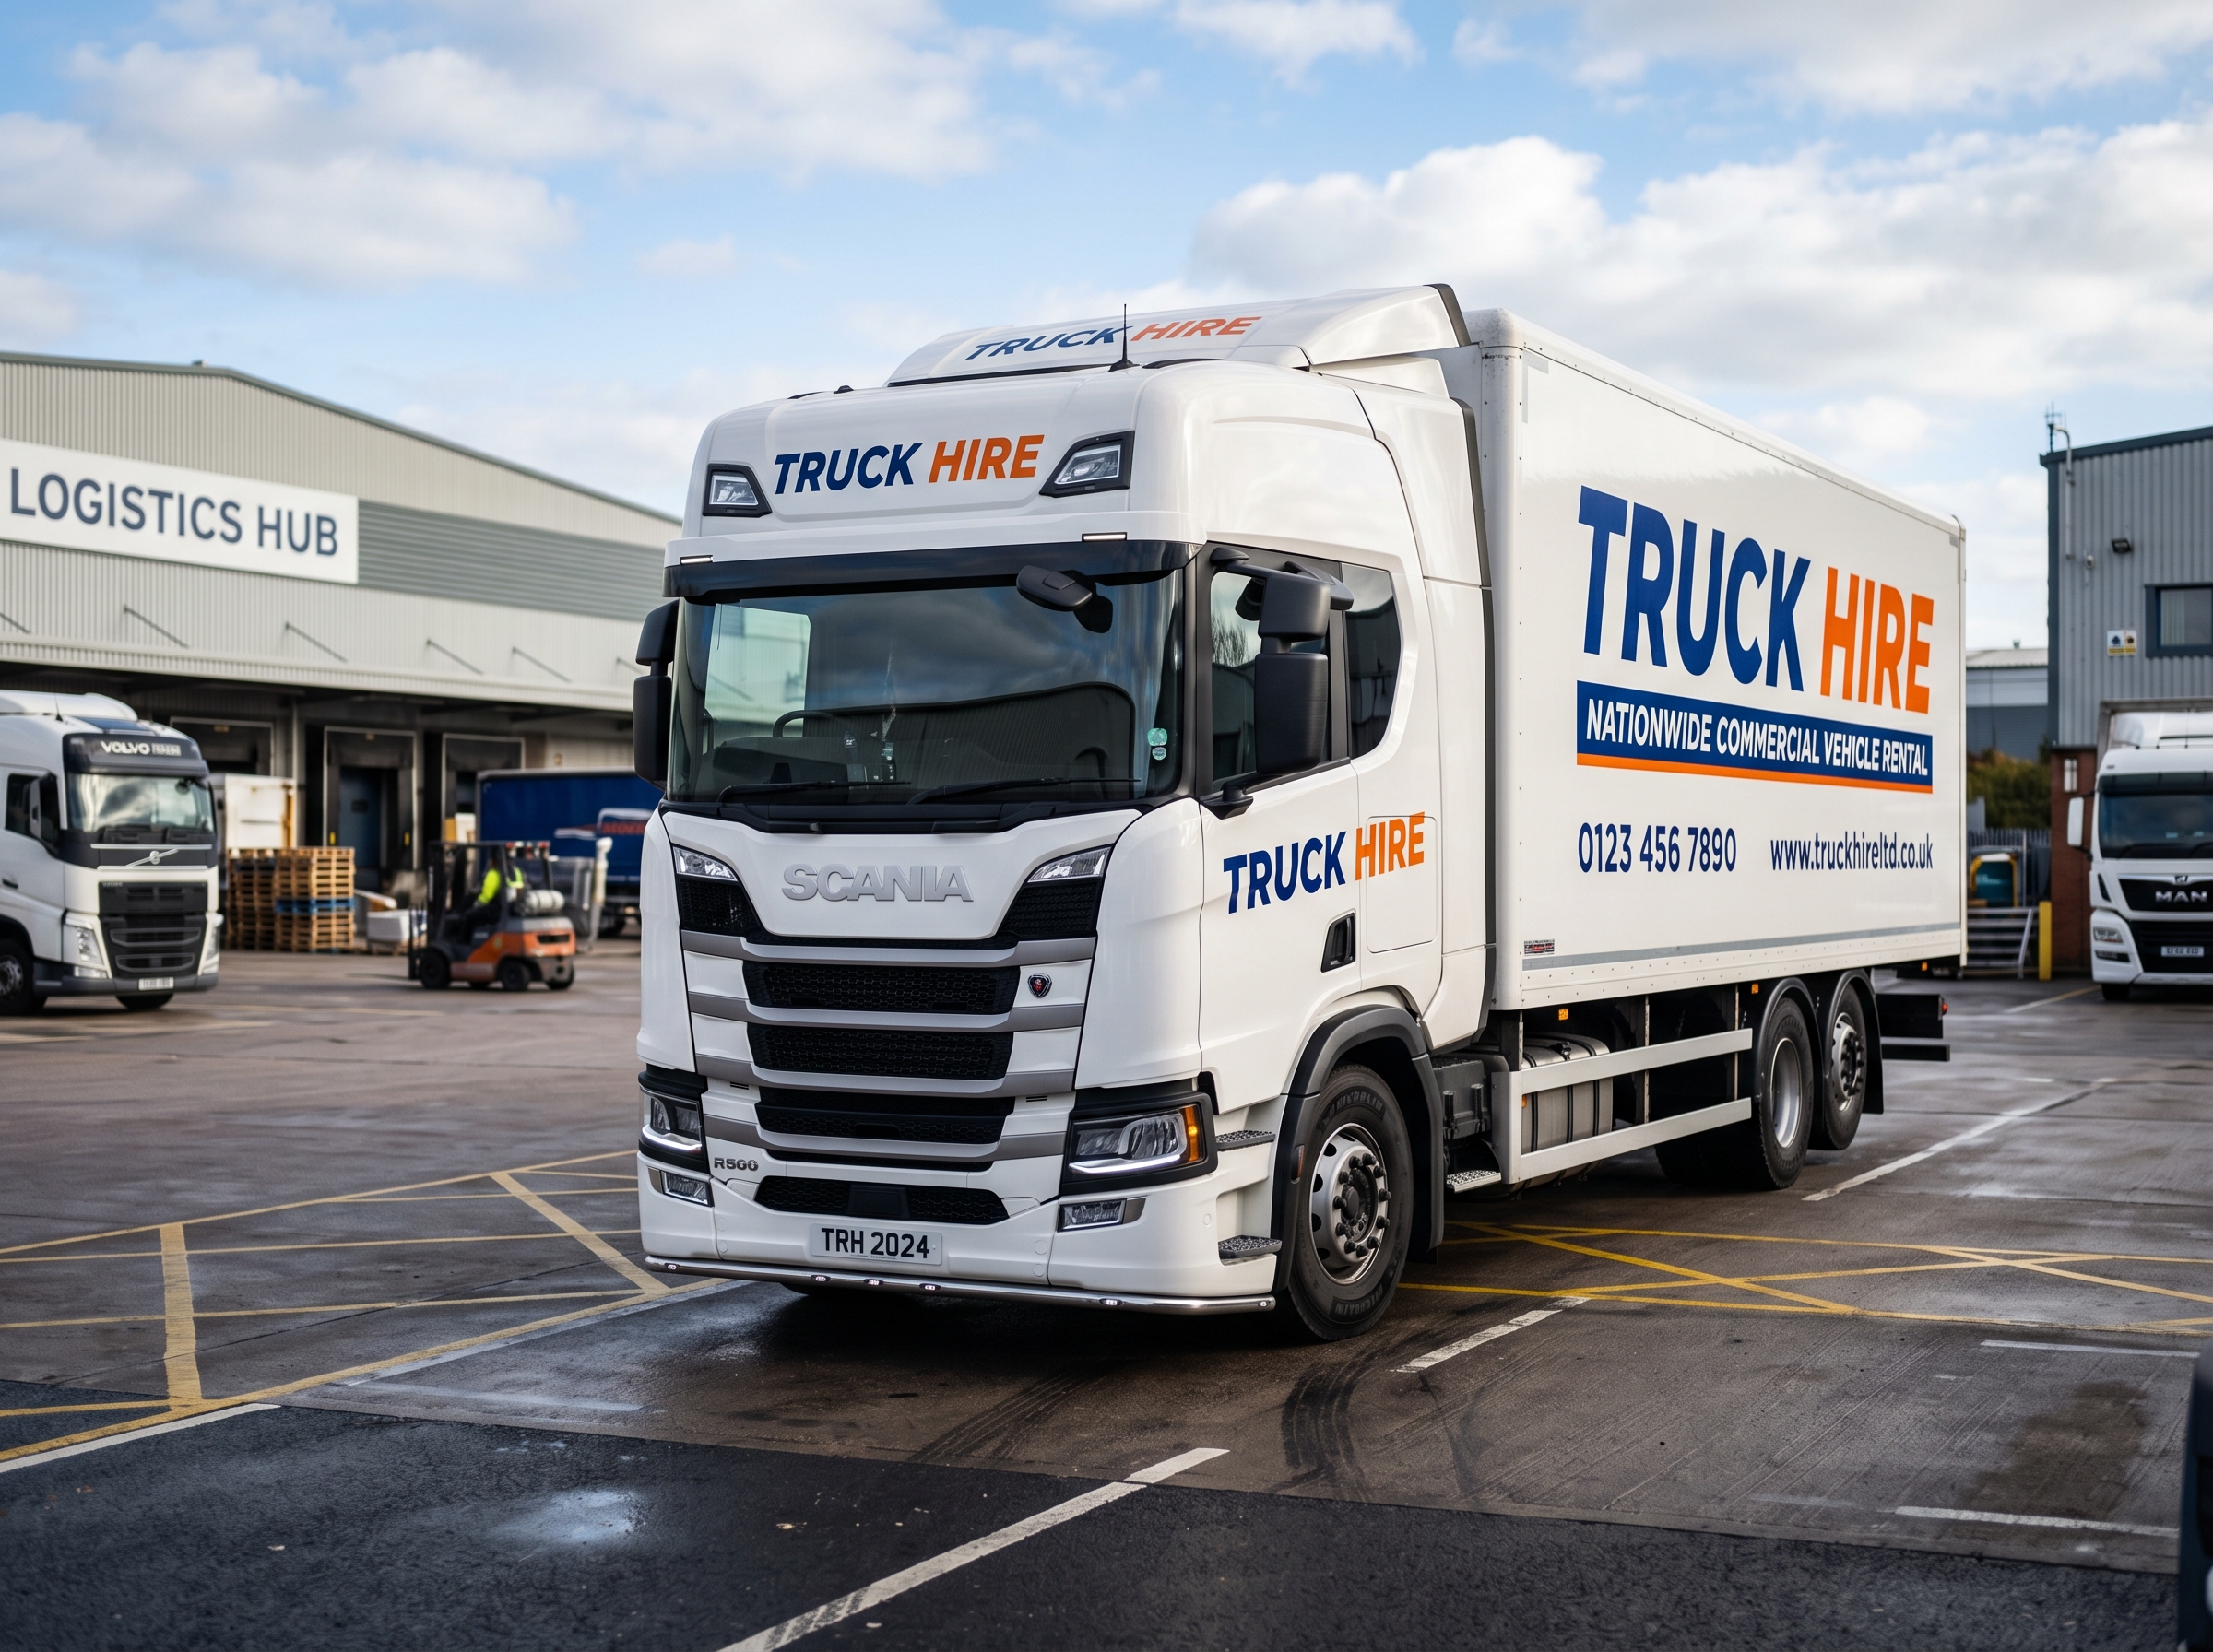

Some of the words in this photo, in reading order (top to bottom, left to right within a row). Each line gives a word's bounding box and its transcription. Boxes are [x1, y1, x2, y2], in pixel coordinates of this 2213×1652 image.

[966, 324, 1130, 360] TRUCK
[1130, 315, 1261, 342] HIRE
[774, 442, 922, 495] TRUCK
[928, 434, 1045, 484] HIRE
[10, 466, 243, 545] LOGISTICS
[258, 506, 337, 557] HUB
[1577, 485, 1811, 692] TRUCK
[1819, 566, 1935, 714] HIRE
[100, 740, 151, 755] VOLVO
[1585, 698, 1713, 752] NATIONWIDE
[1716, 716, 1820, 764] COMMERCIAL
[1823, 730, 1880, 771] VEHICLE
[1882, 739, 1929, 776] RENTAL
[1223, 831, 1347, 914] TRUCK
[1354, 811, 1426, 882] HIRE
[1578, 822, 1632, 873] 0123
[1639, 825, 1680, 873] 456
[1687, 827, 1737, 873] 7890
[1770, 831, 1934, 872] www.truckhireltd.co.uk
[782, 864, 974, 902] SCANIA
[2155, 891, 2208, 903] MAN
[714, 1157, 759, 1172] R500
[821, 1227, 864, 1254] TRH
[870, 1231, 930, 1259] 2024
